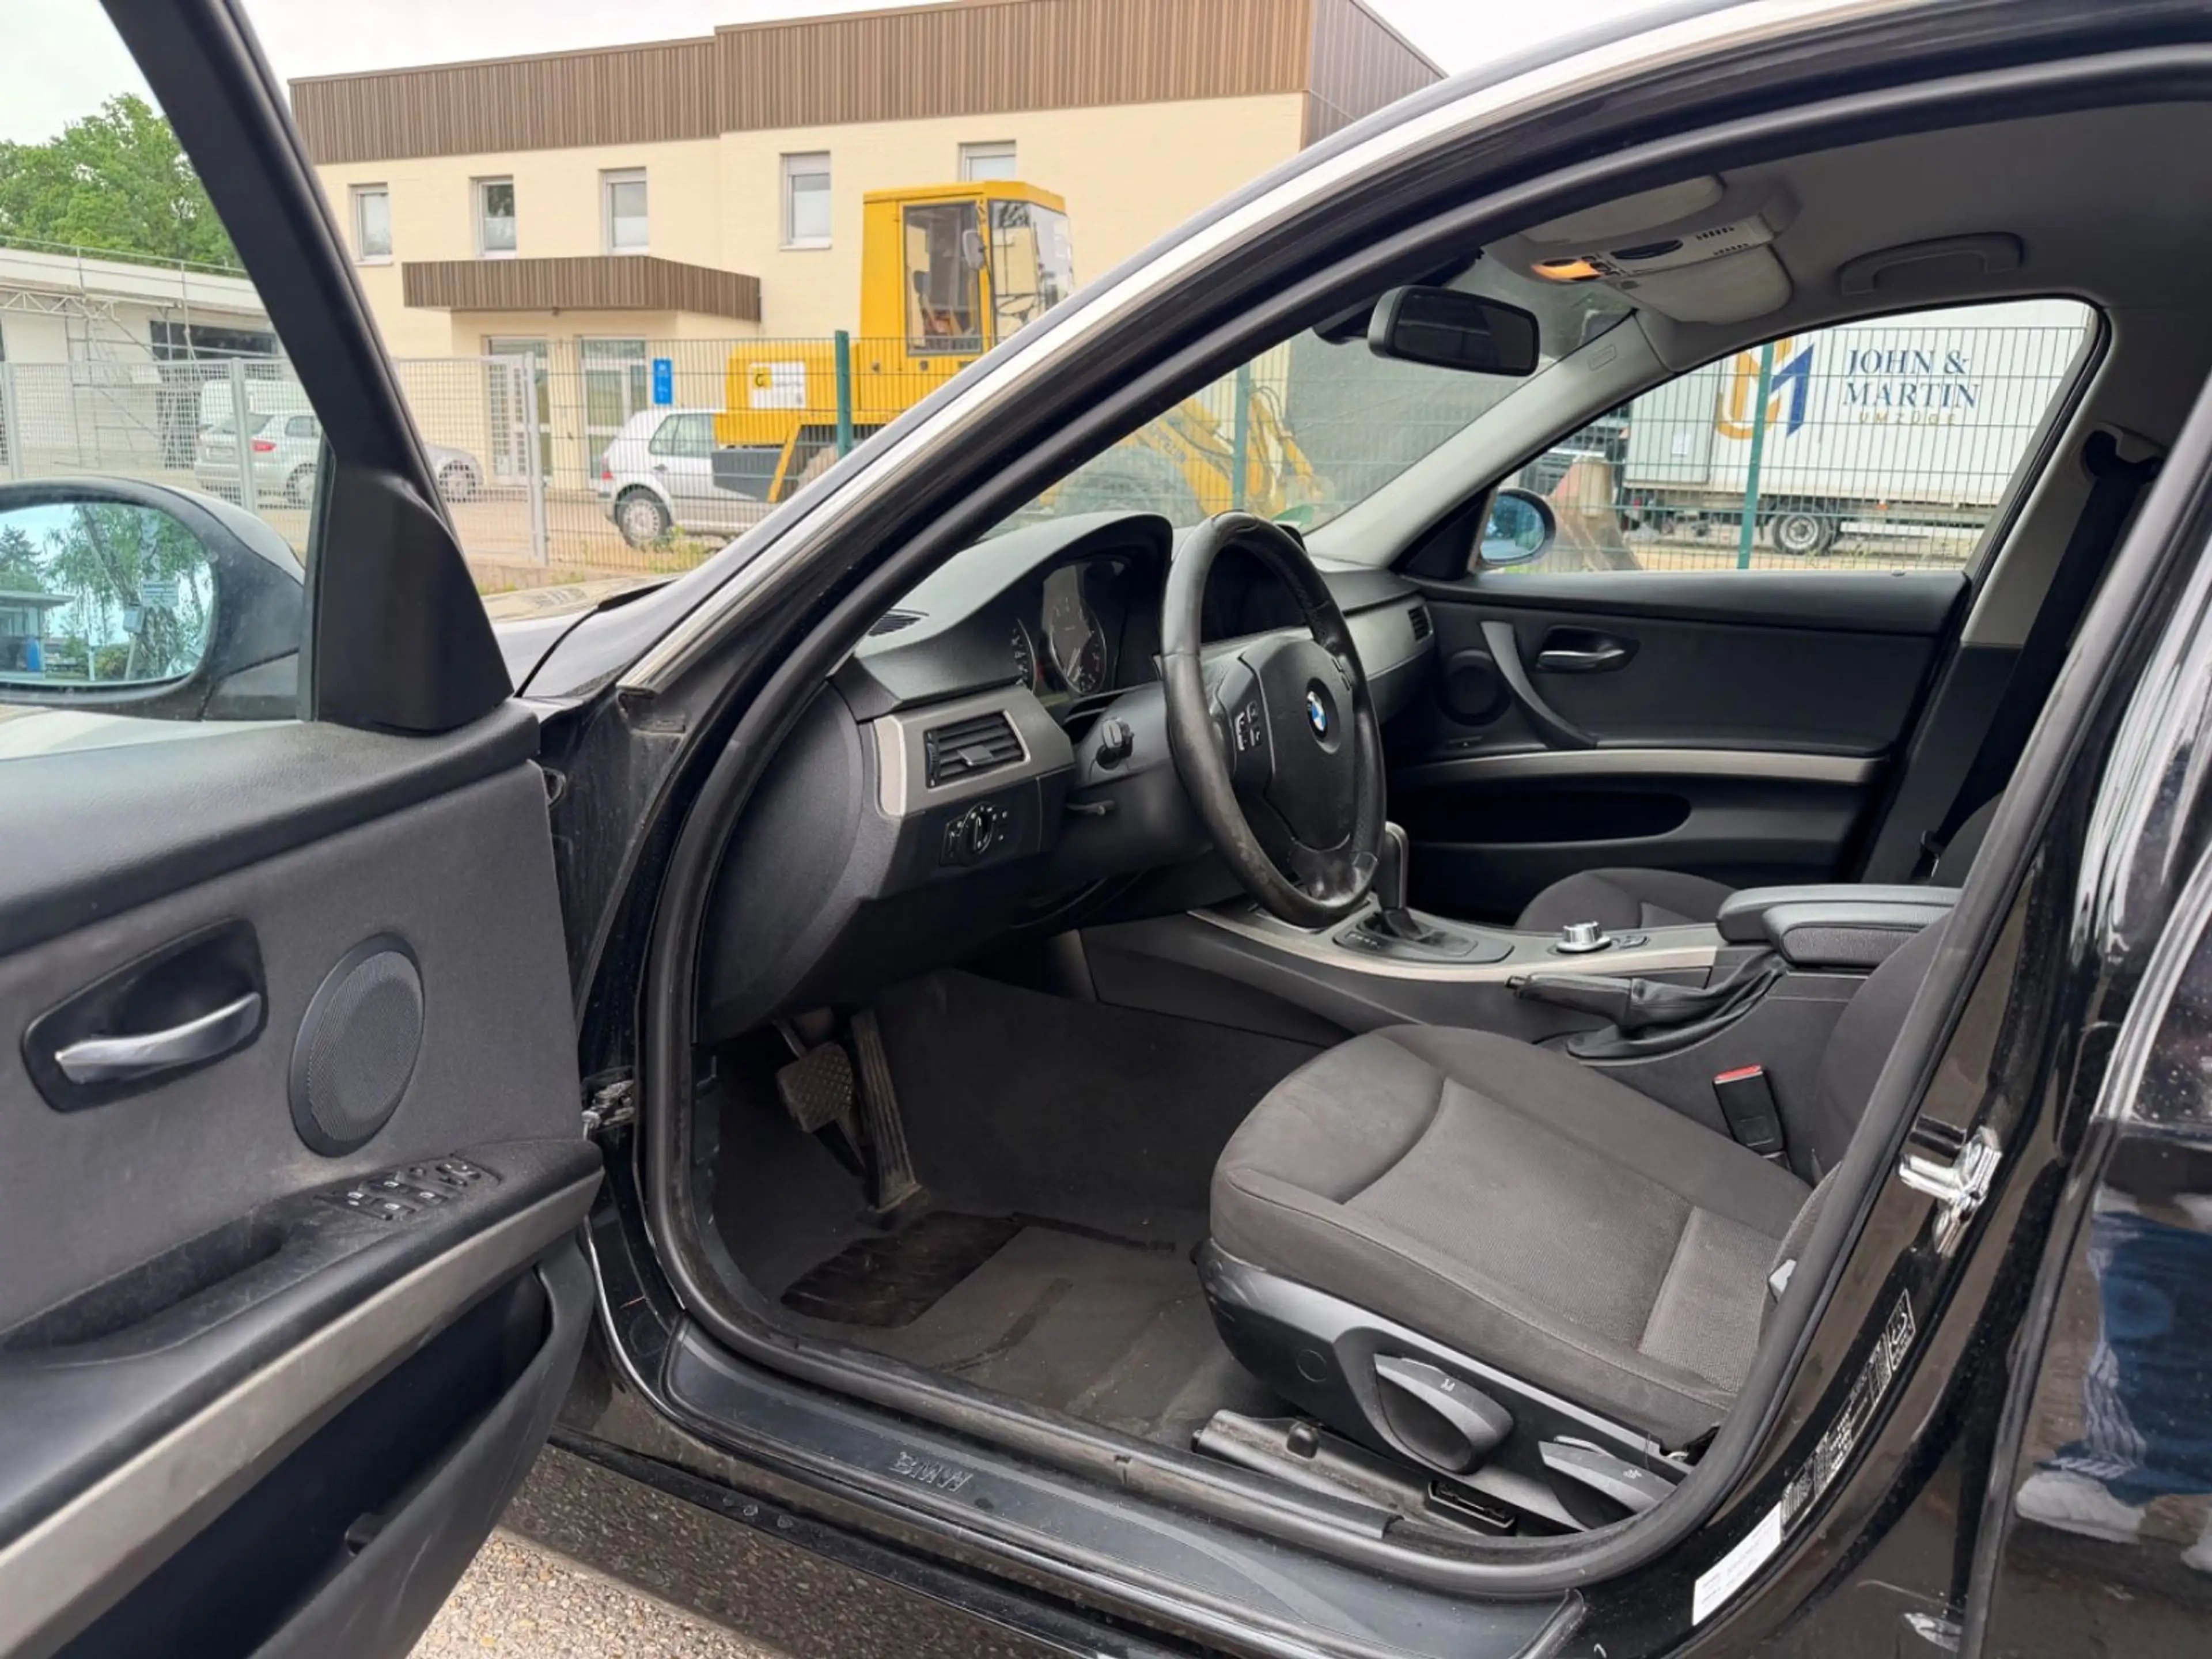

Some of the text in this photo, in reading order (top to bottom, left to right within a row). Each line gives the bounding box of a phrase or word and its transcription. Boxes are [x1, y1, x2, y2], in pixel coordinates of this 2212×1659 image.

[1847, 349, 1969, 377] JOHN &
[1842, 382, 1981, 408] MARTIN
